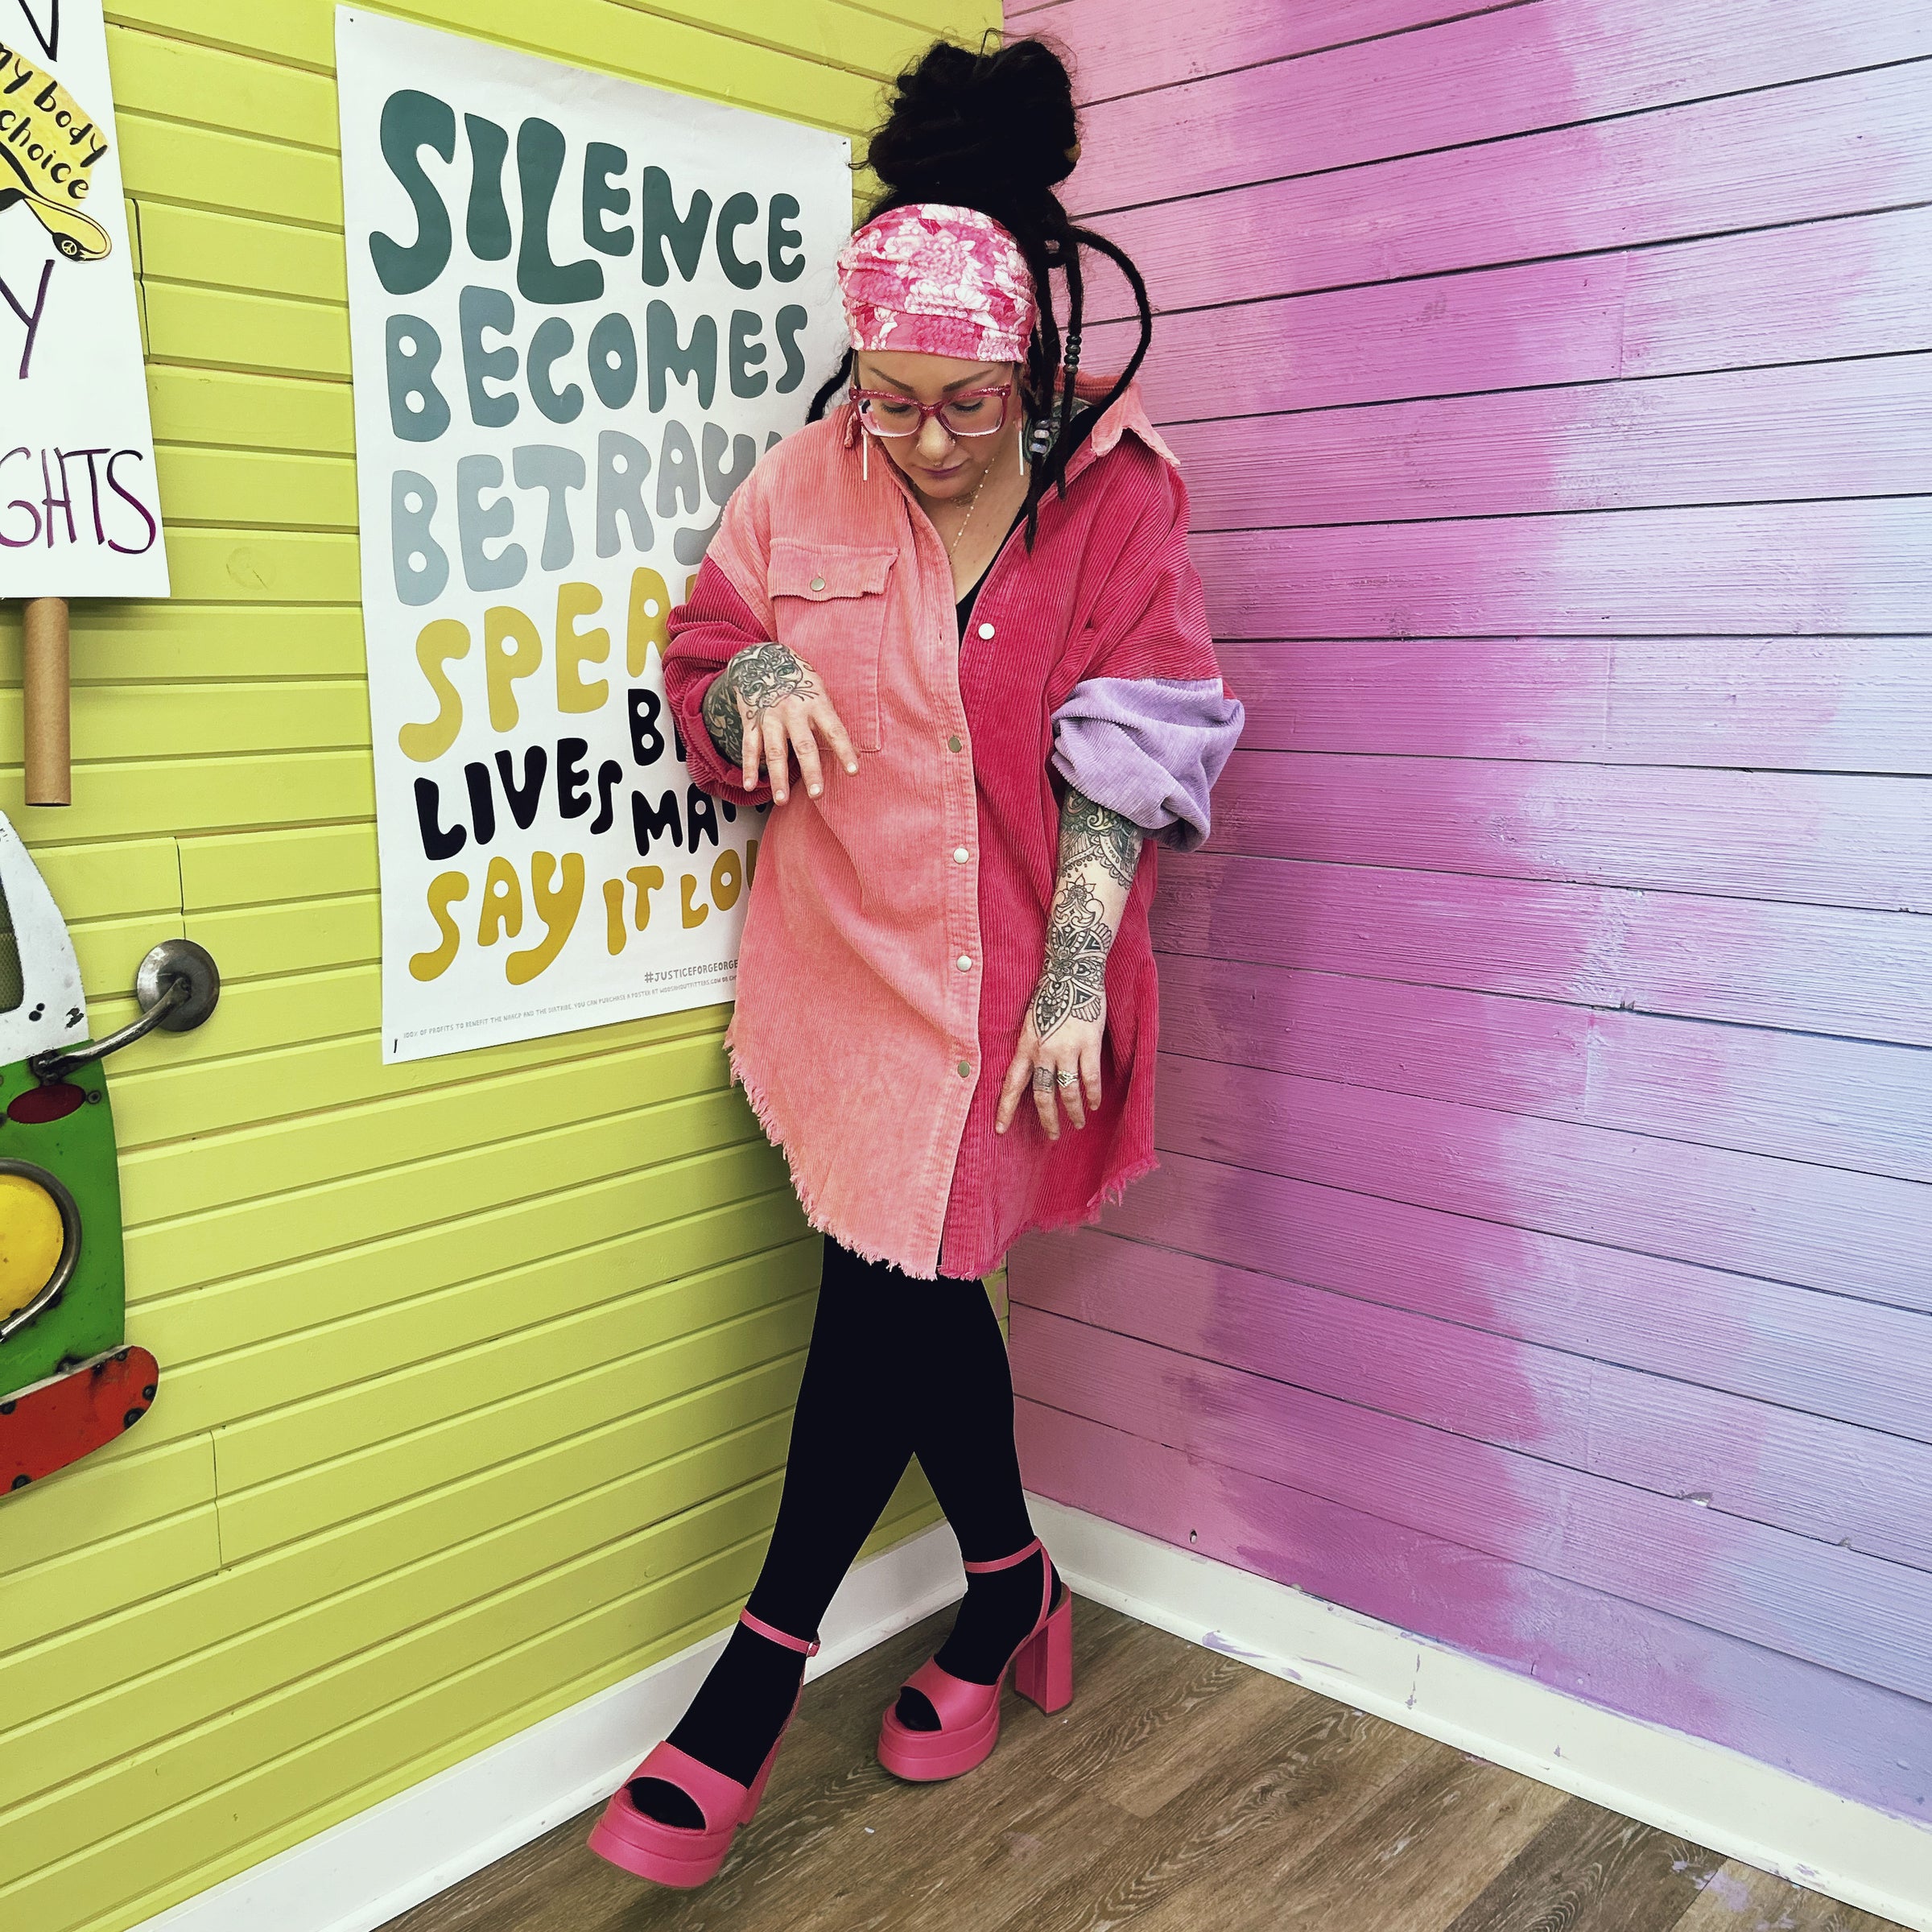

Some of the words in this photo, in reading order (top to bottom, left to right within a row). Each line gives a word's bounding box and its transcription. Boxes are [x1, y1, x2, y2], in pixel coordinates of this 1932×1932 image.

[0, 109, 89, 199] choice
[34, 80, 107, 167] body
[369, 89, 806, 304] SILENCE
[386, 285, 807, 442] BECOMES
[391, 420, 782, 606] BETRAY
[398, 567, 698, 762] SPEA
[414, 737, 623, 861] LIVES
[409, 851, 585, 985] SAY
[603, 865, 664, 956] IT
[645, 959, 738, 983] #JUSTICEFORGEORGE
[428, 1024, 454, 1034] PROFITS
[464, 1018, 489, 1028] BENEFIT
[489, 1016, 502, 1024] THE
[535, 1008, 547, 1016] THE
[573, 1001, 586, 1009] YOU
[586, 999, 598, 1007] CAN
[598, 993, 626, 1005] PURCHASE
[630, 990, 651, 998] POSTER
